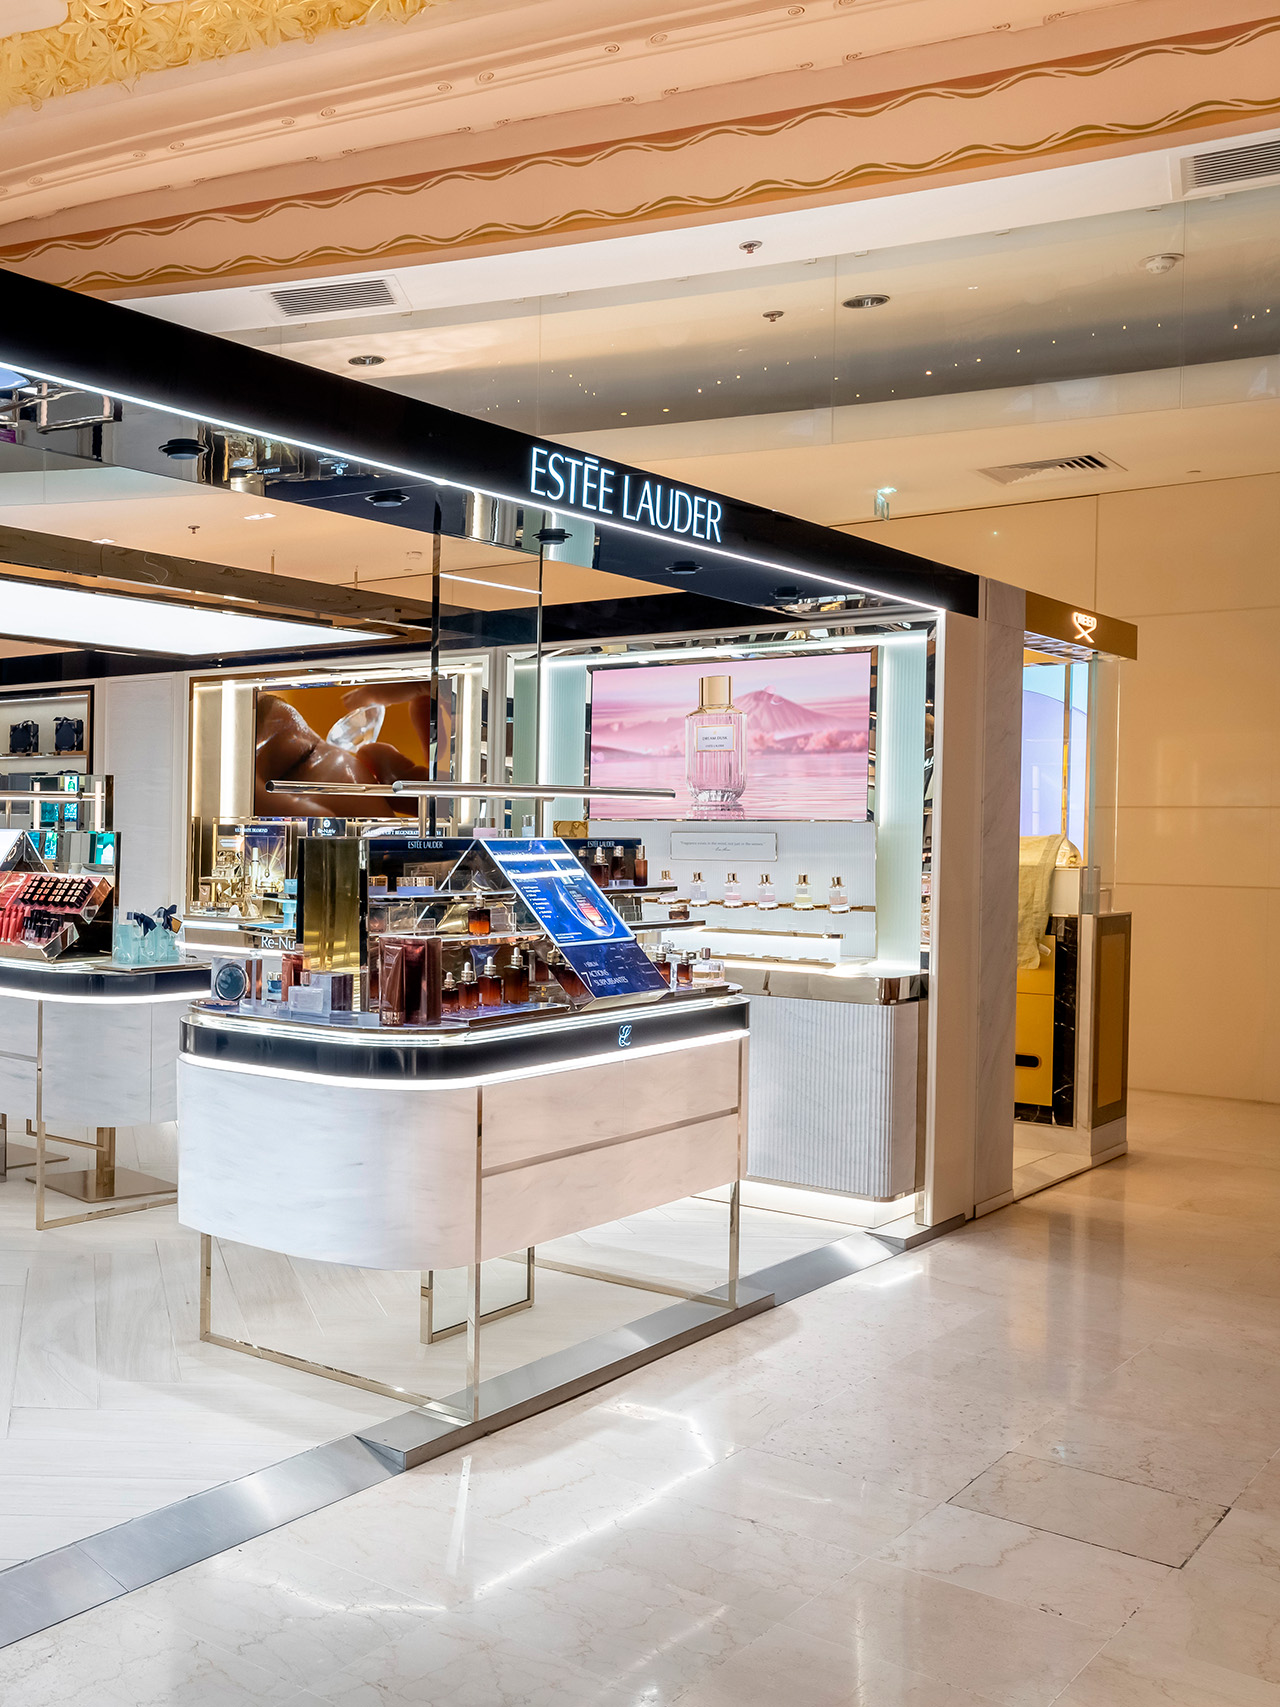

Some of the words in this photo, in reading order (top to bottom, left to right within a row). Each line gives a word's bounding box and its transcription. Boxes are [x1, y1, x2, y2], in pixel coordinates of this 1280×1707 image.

[622, 475, 722, 544] LAUDER
[423, 841, 444, 849] LAUDER
[261, 935, 296, 950] Re-Nu
[580, 971, 593, 987] 7
